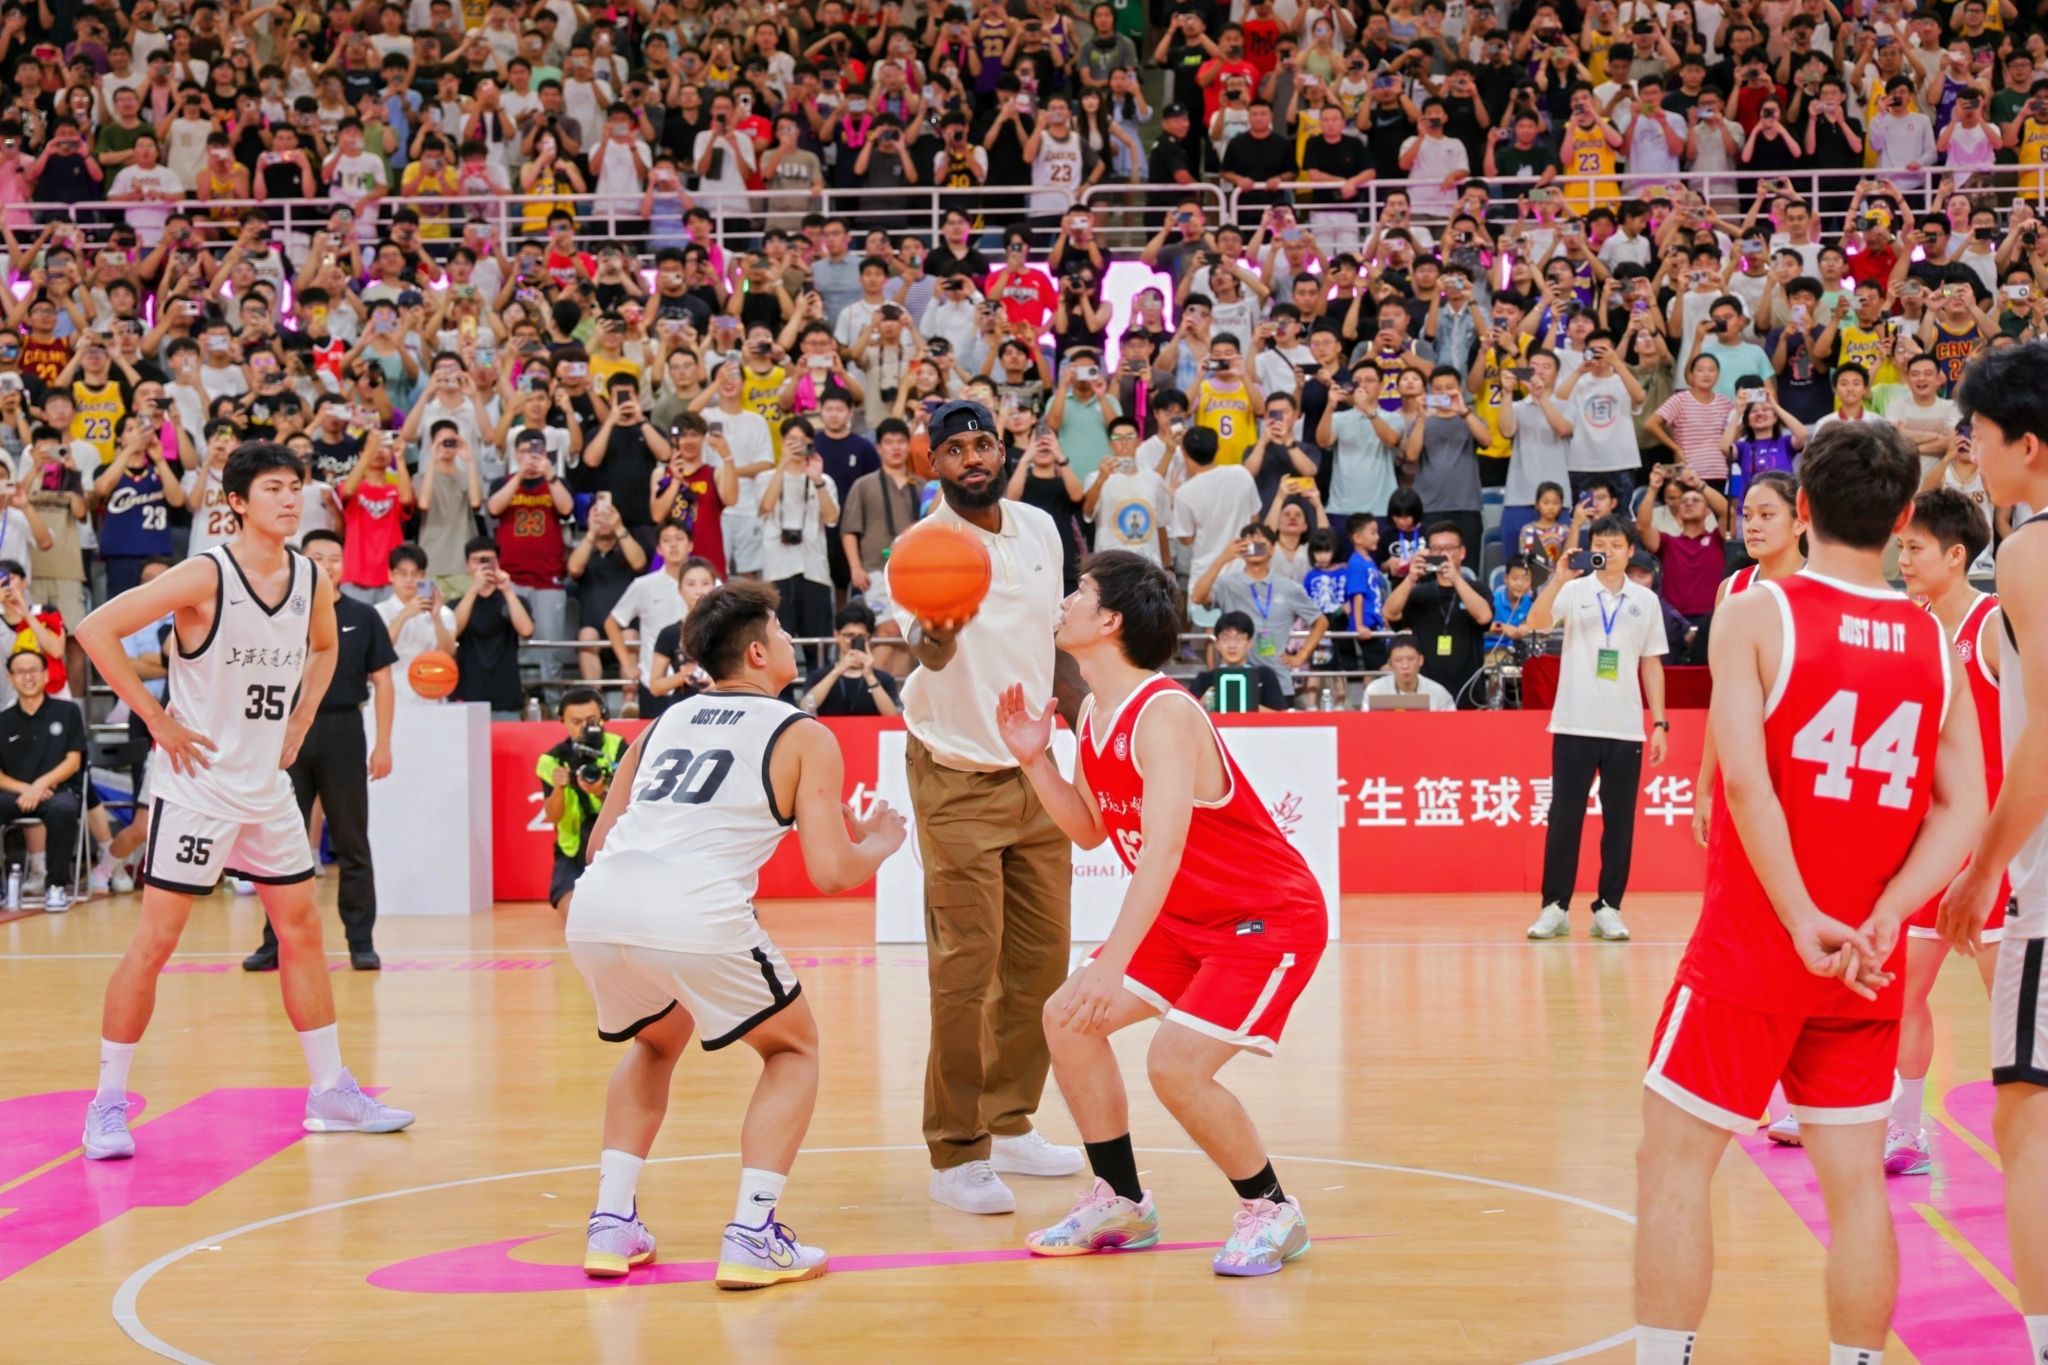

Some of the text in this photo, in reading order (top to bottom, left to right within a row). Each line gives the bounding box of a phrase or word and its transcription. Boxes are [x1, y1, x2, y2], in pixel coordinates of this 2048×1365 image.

[1050, 165, 1072, 183] 23
[1578, 154, 1600, 173] 23
[1936, 341, 1972, 360] CAV
[1949, 359, 1963, 381] 2
[84, 417, 112, 441] 23
[1220, 414, 1233, 437] 6
[204, 488, 228, 508] CA
[142, 504, 168, 531] 23
[208, 511, 237, 535] 23
[514, 509, 546, 537] 23
[1838, 613, 1906, 653] JUST DO IT
[245, 684, 286, 721] 35
[691, 708, 746, 725] JUST DO IT
[1791, 689, 1924, 810] 44
[637, 748, 735, 804] 30
[175, 834, 213, 867] 35
[1072, 864, 1115, 877] GHAI
